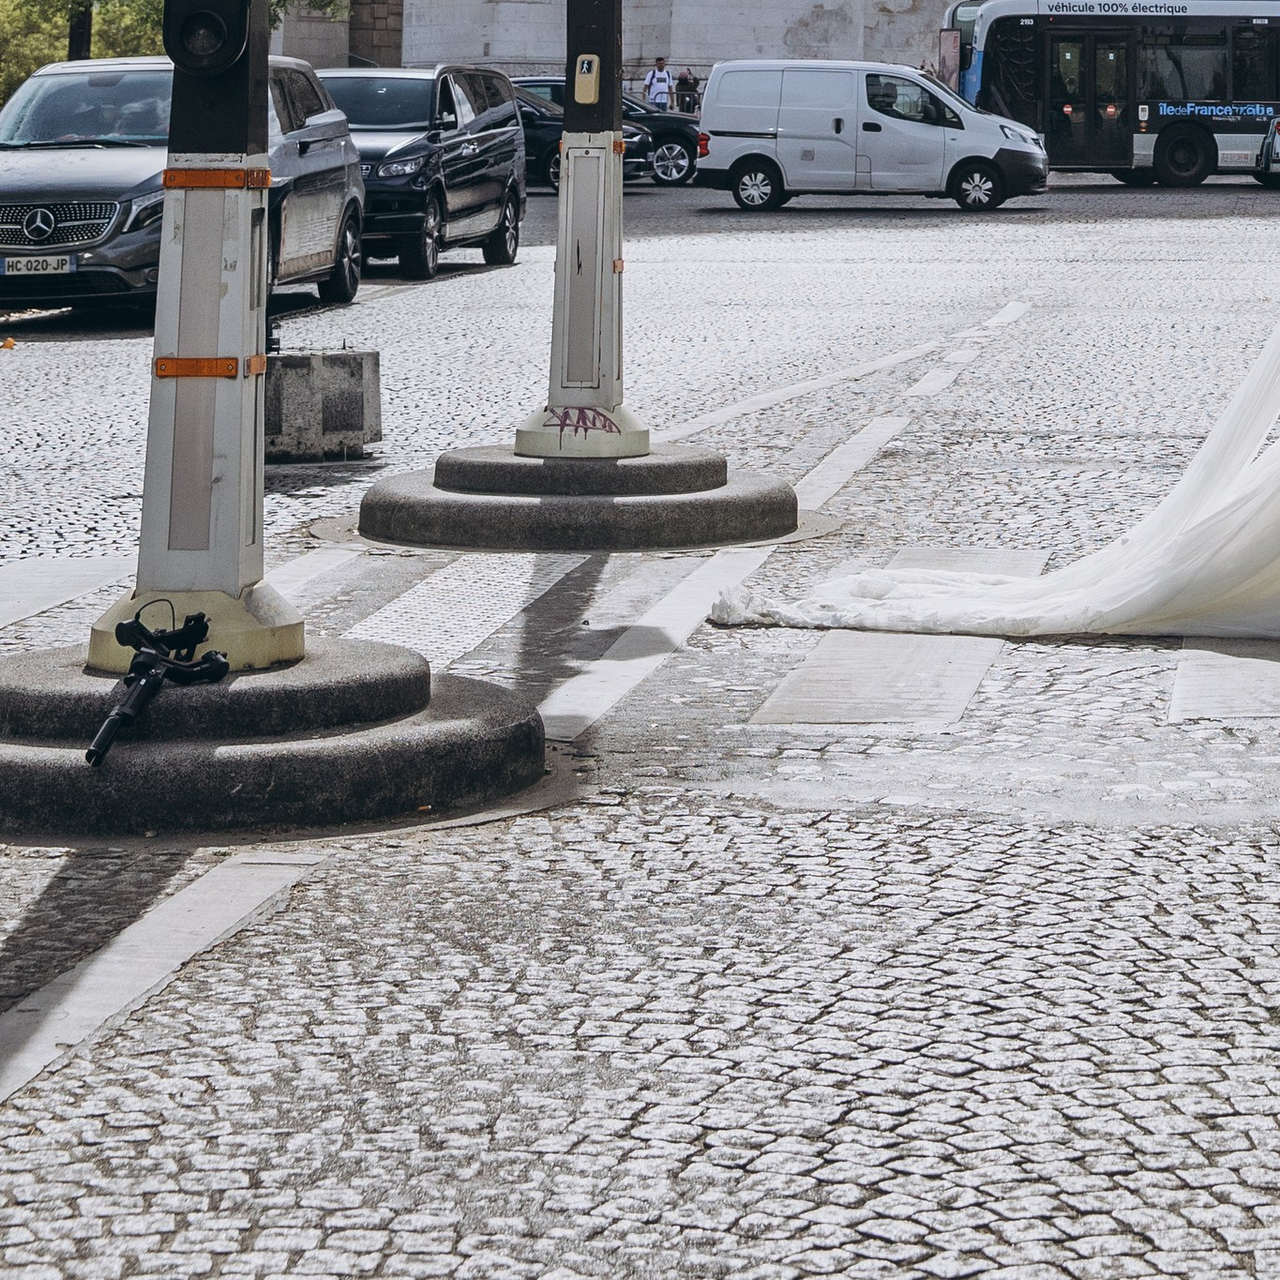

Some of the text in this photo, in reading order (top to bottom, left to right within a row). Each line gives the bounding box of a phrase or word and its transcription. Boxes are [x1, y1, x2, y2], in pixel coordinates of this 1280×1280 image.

[1047, 1, 1188, 15] véhicule 100% électrique
[7, 258, 68, 272] HC-020-JP
